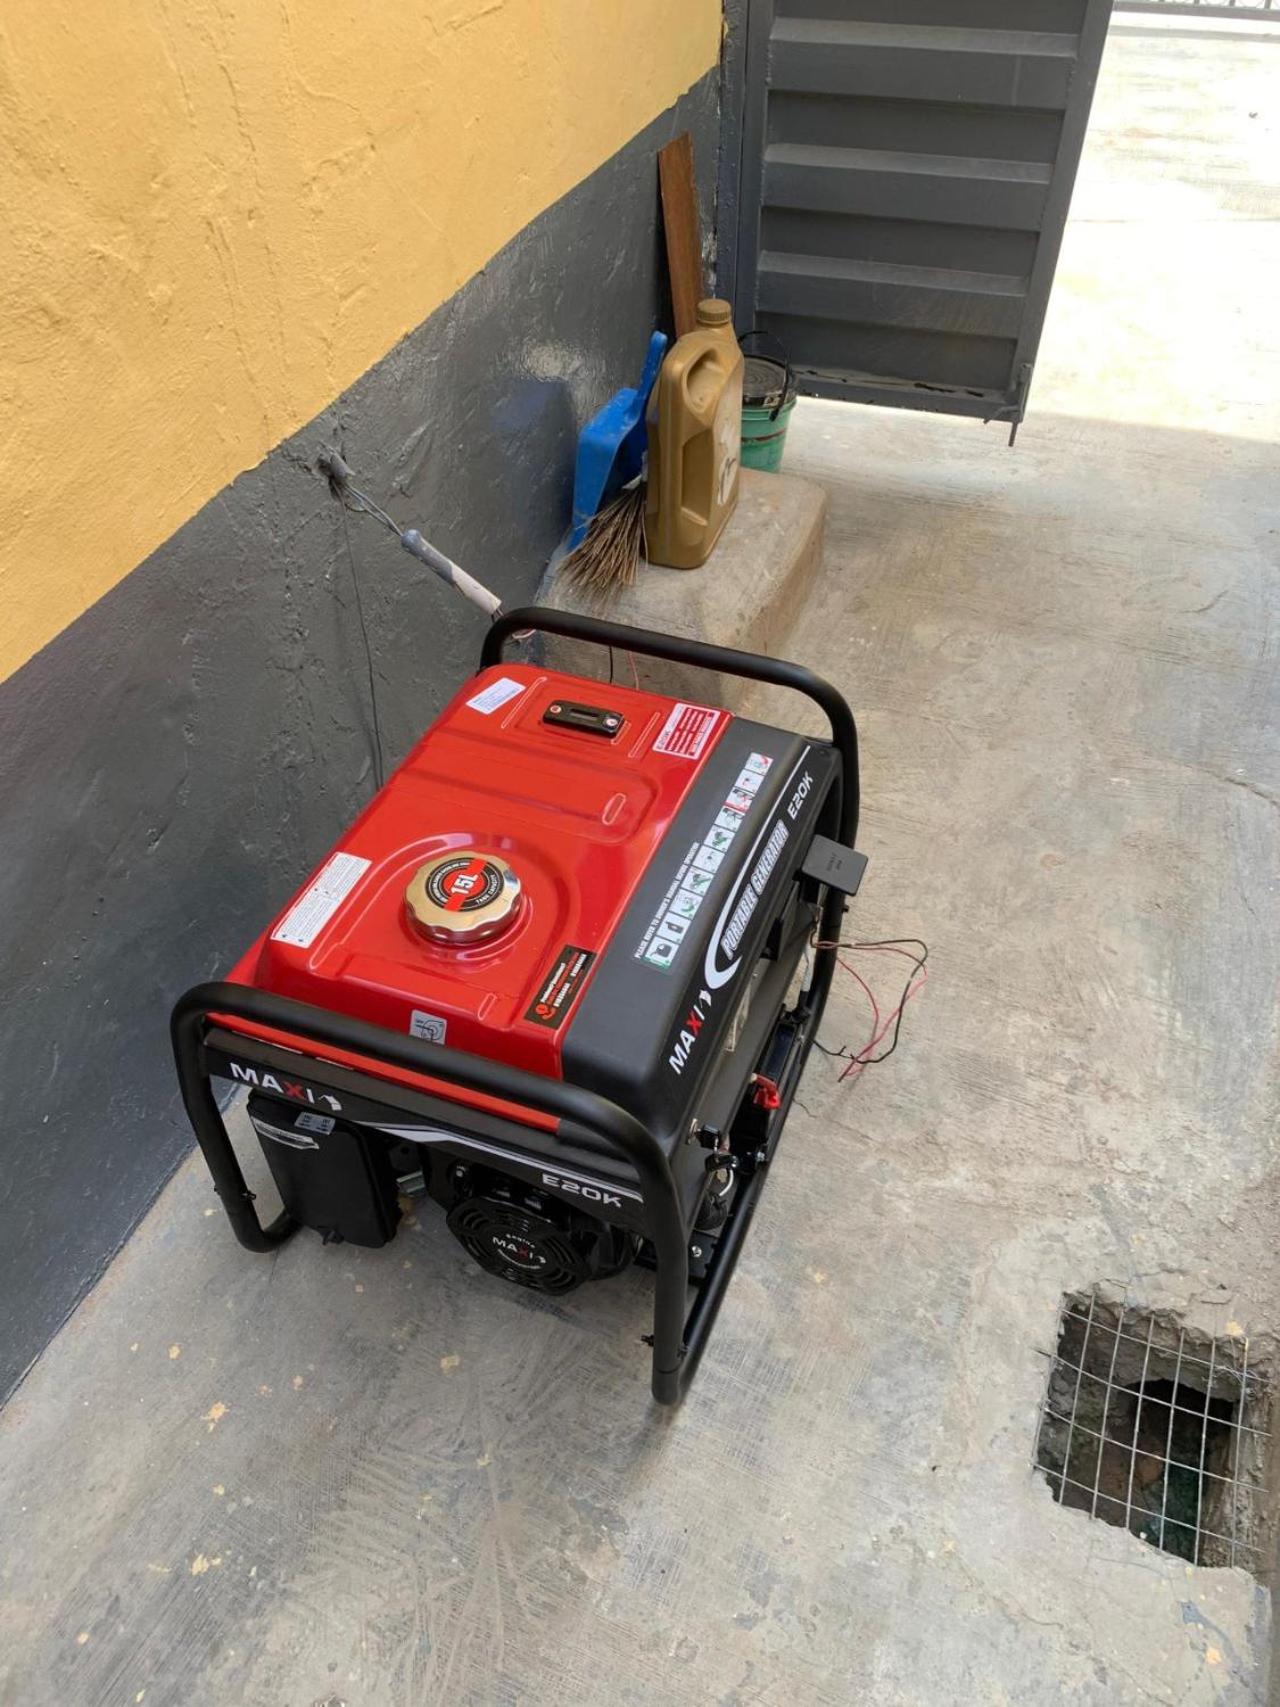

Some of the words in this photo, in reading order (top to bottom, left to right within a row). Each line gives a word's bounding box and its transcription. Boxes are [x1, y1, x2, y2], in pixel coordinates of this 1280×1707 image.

[787, 771, 813, 821] E20K
[450, 874, 479, 894] 15L
[721, 883, 759, 960] PORTABLE
[750, 819, 789, 896] GENERATOR
[669, 1004, 705, 1075] MAXI
[230, 1062, 315, 1104] MAXI
[542, 1173, 622, 1208] E20K
[492, 1236, 534, 1260] MAXI
